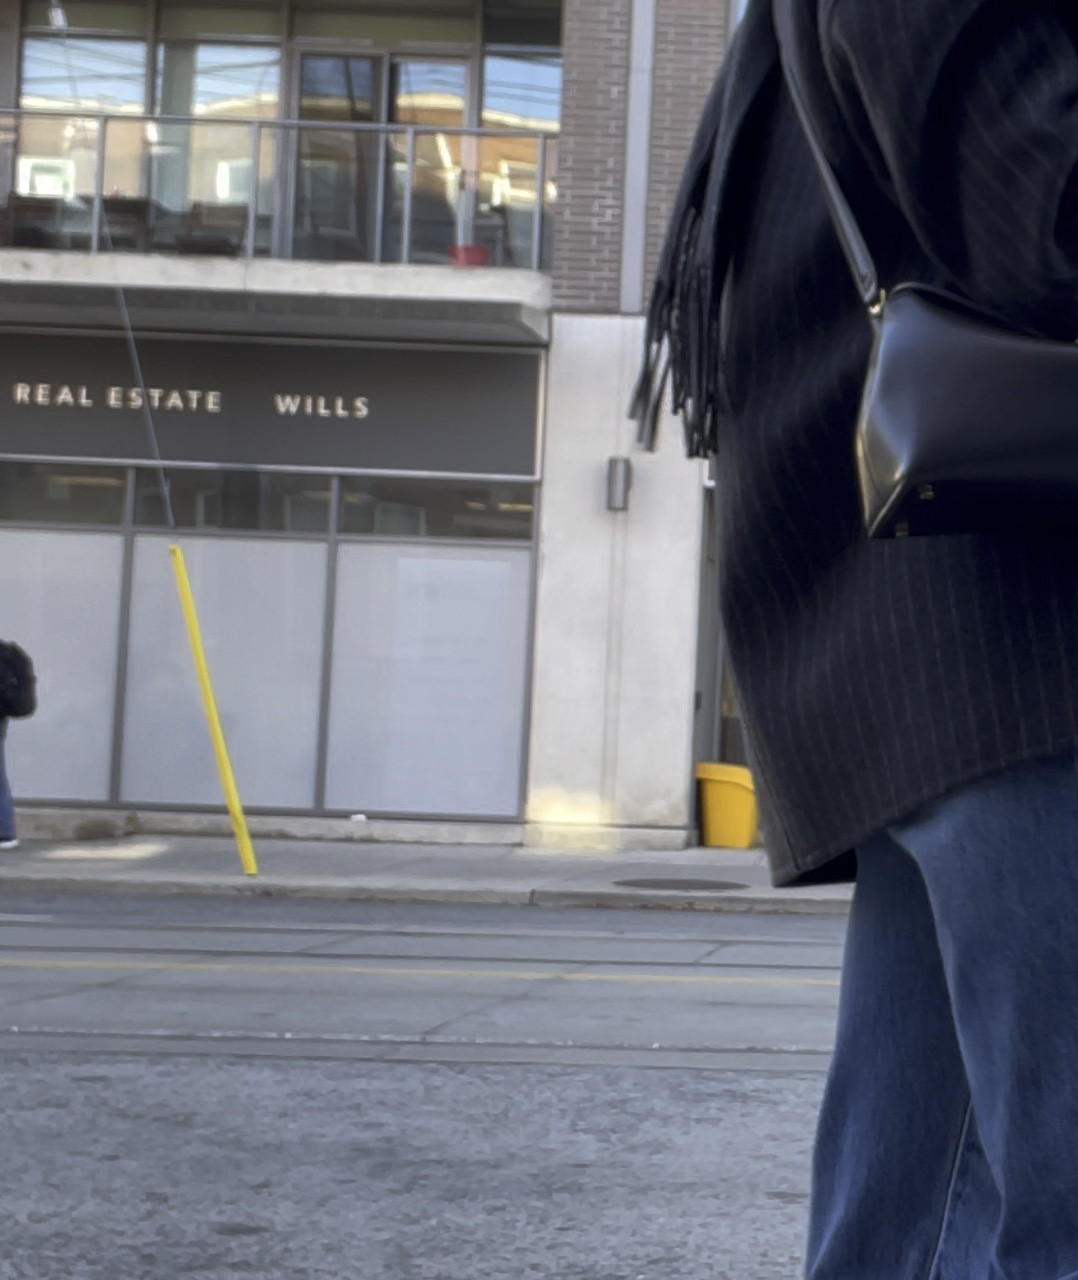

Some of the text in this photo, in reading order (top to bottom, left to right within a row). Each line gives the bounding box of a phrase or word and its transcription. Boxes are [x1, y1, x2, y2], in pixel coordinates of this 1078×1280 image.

[12, 381, 223, 413] REAL ESTATE
[274, 393, 370, 419] WILLS
